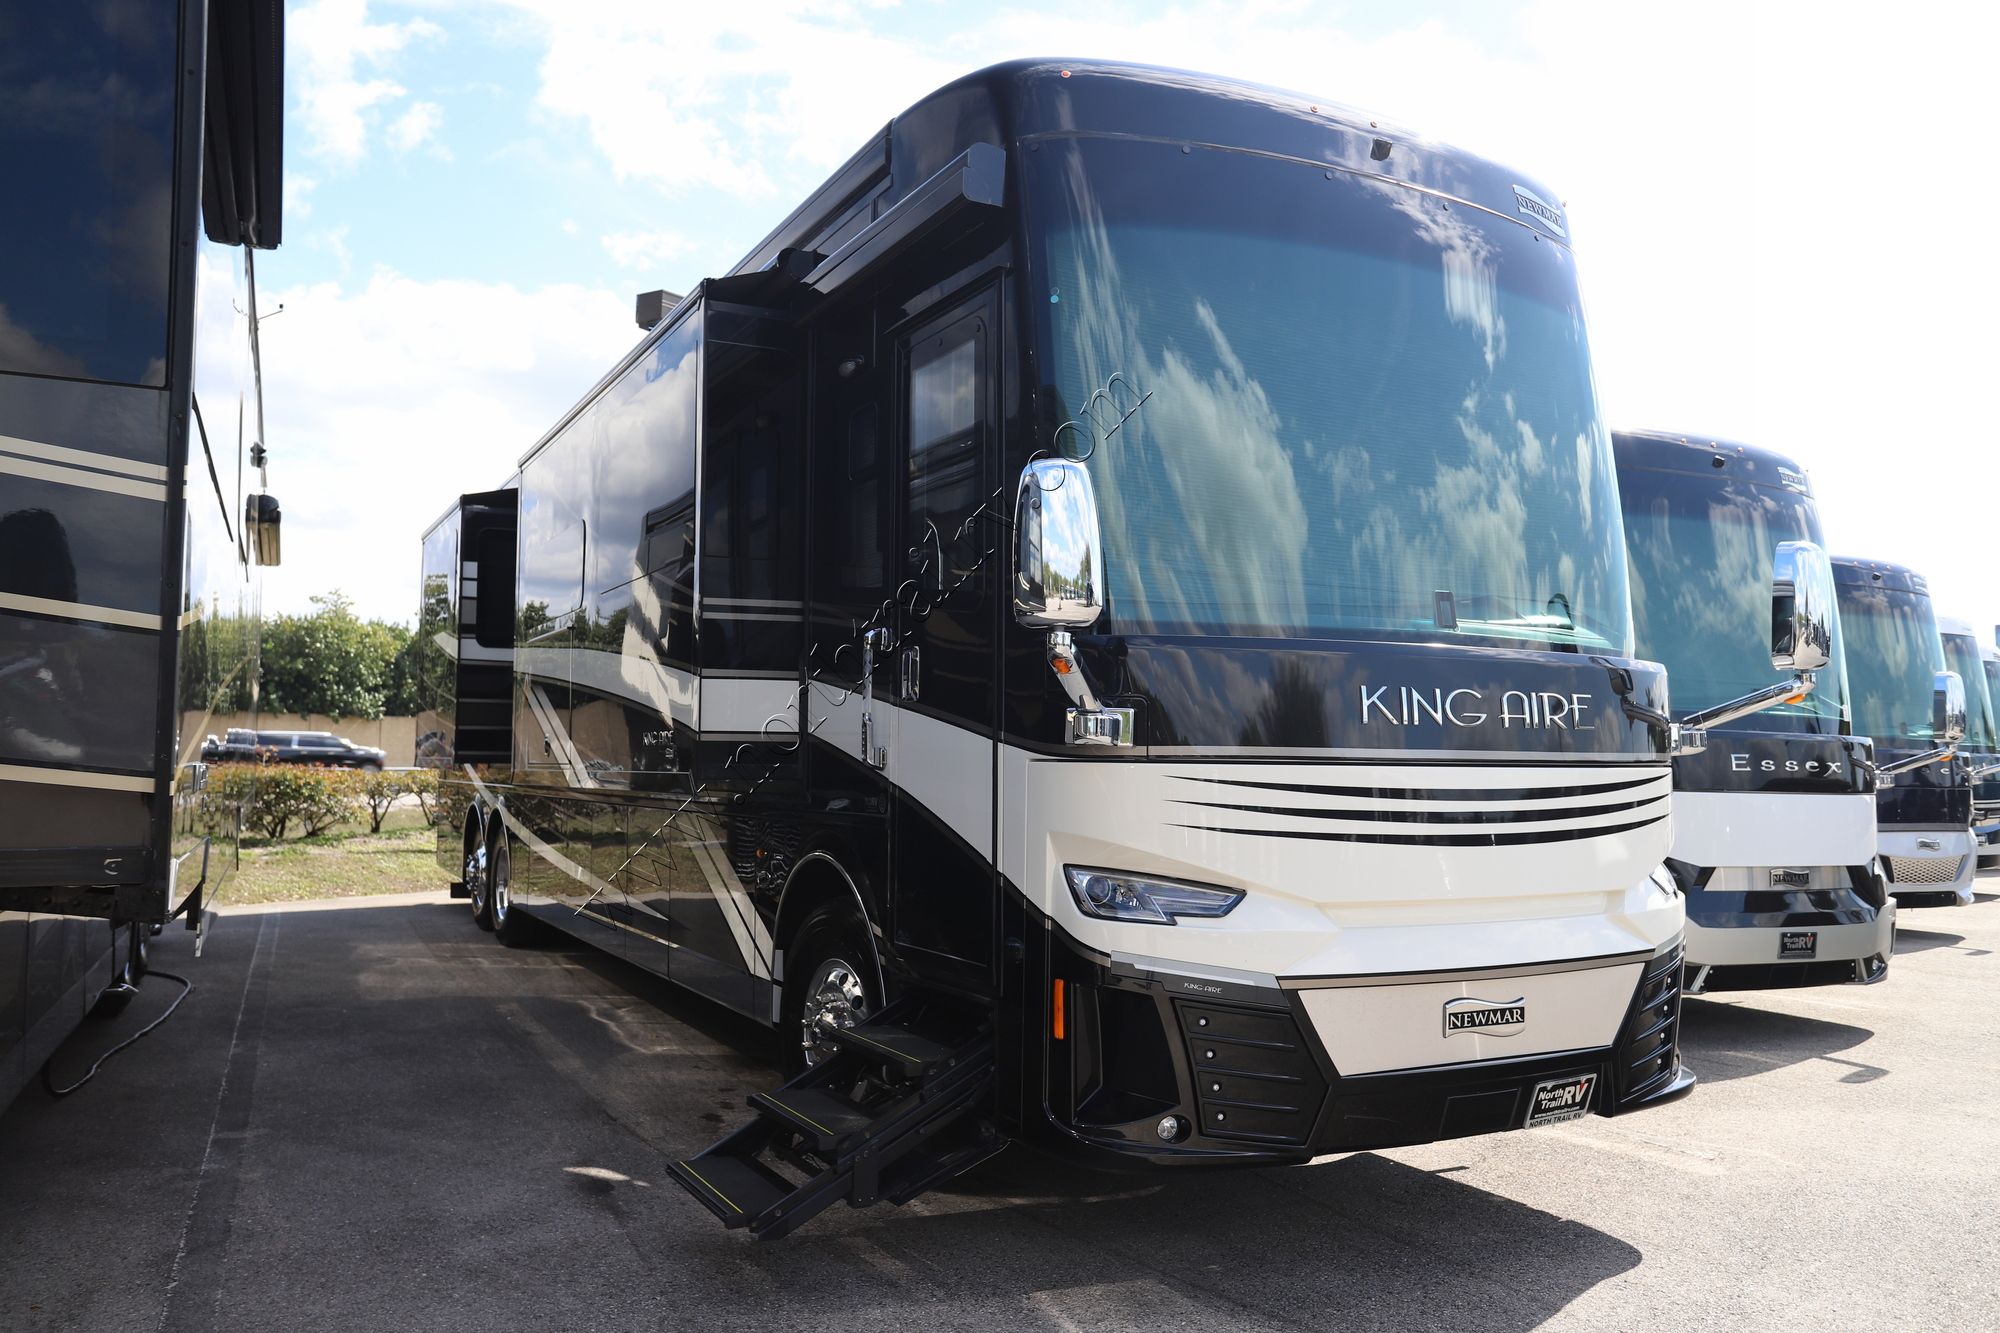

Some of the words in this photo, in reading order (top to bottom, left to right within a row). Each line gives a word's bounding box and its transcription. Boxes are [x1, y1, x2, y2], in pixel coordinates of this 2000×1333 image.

[1516, 194, 1562, 228] NEWMAR
[1360, 685, 1487, 727] KING
[1498, 690, 1595, 730] AIRE
[1730, 753, 1842, 777] Essex
[1799, 936, 1814, 949] RV
[1184, 982, 1203, 991] KING
[1204, 985, 1222, 994] AIRE
[1449, 1008, 1524, 1028] NEWMAR
[1538, 1088, 1565, 1101] North
[1561, 1082, 1589, 1106] RV
[1541, 1097, 1562, 1109] Trail
[1529, 1118, 1552, 1128] NORTH
[1553, 1115, 1572, 1124] TRAIL
